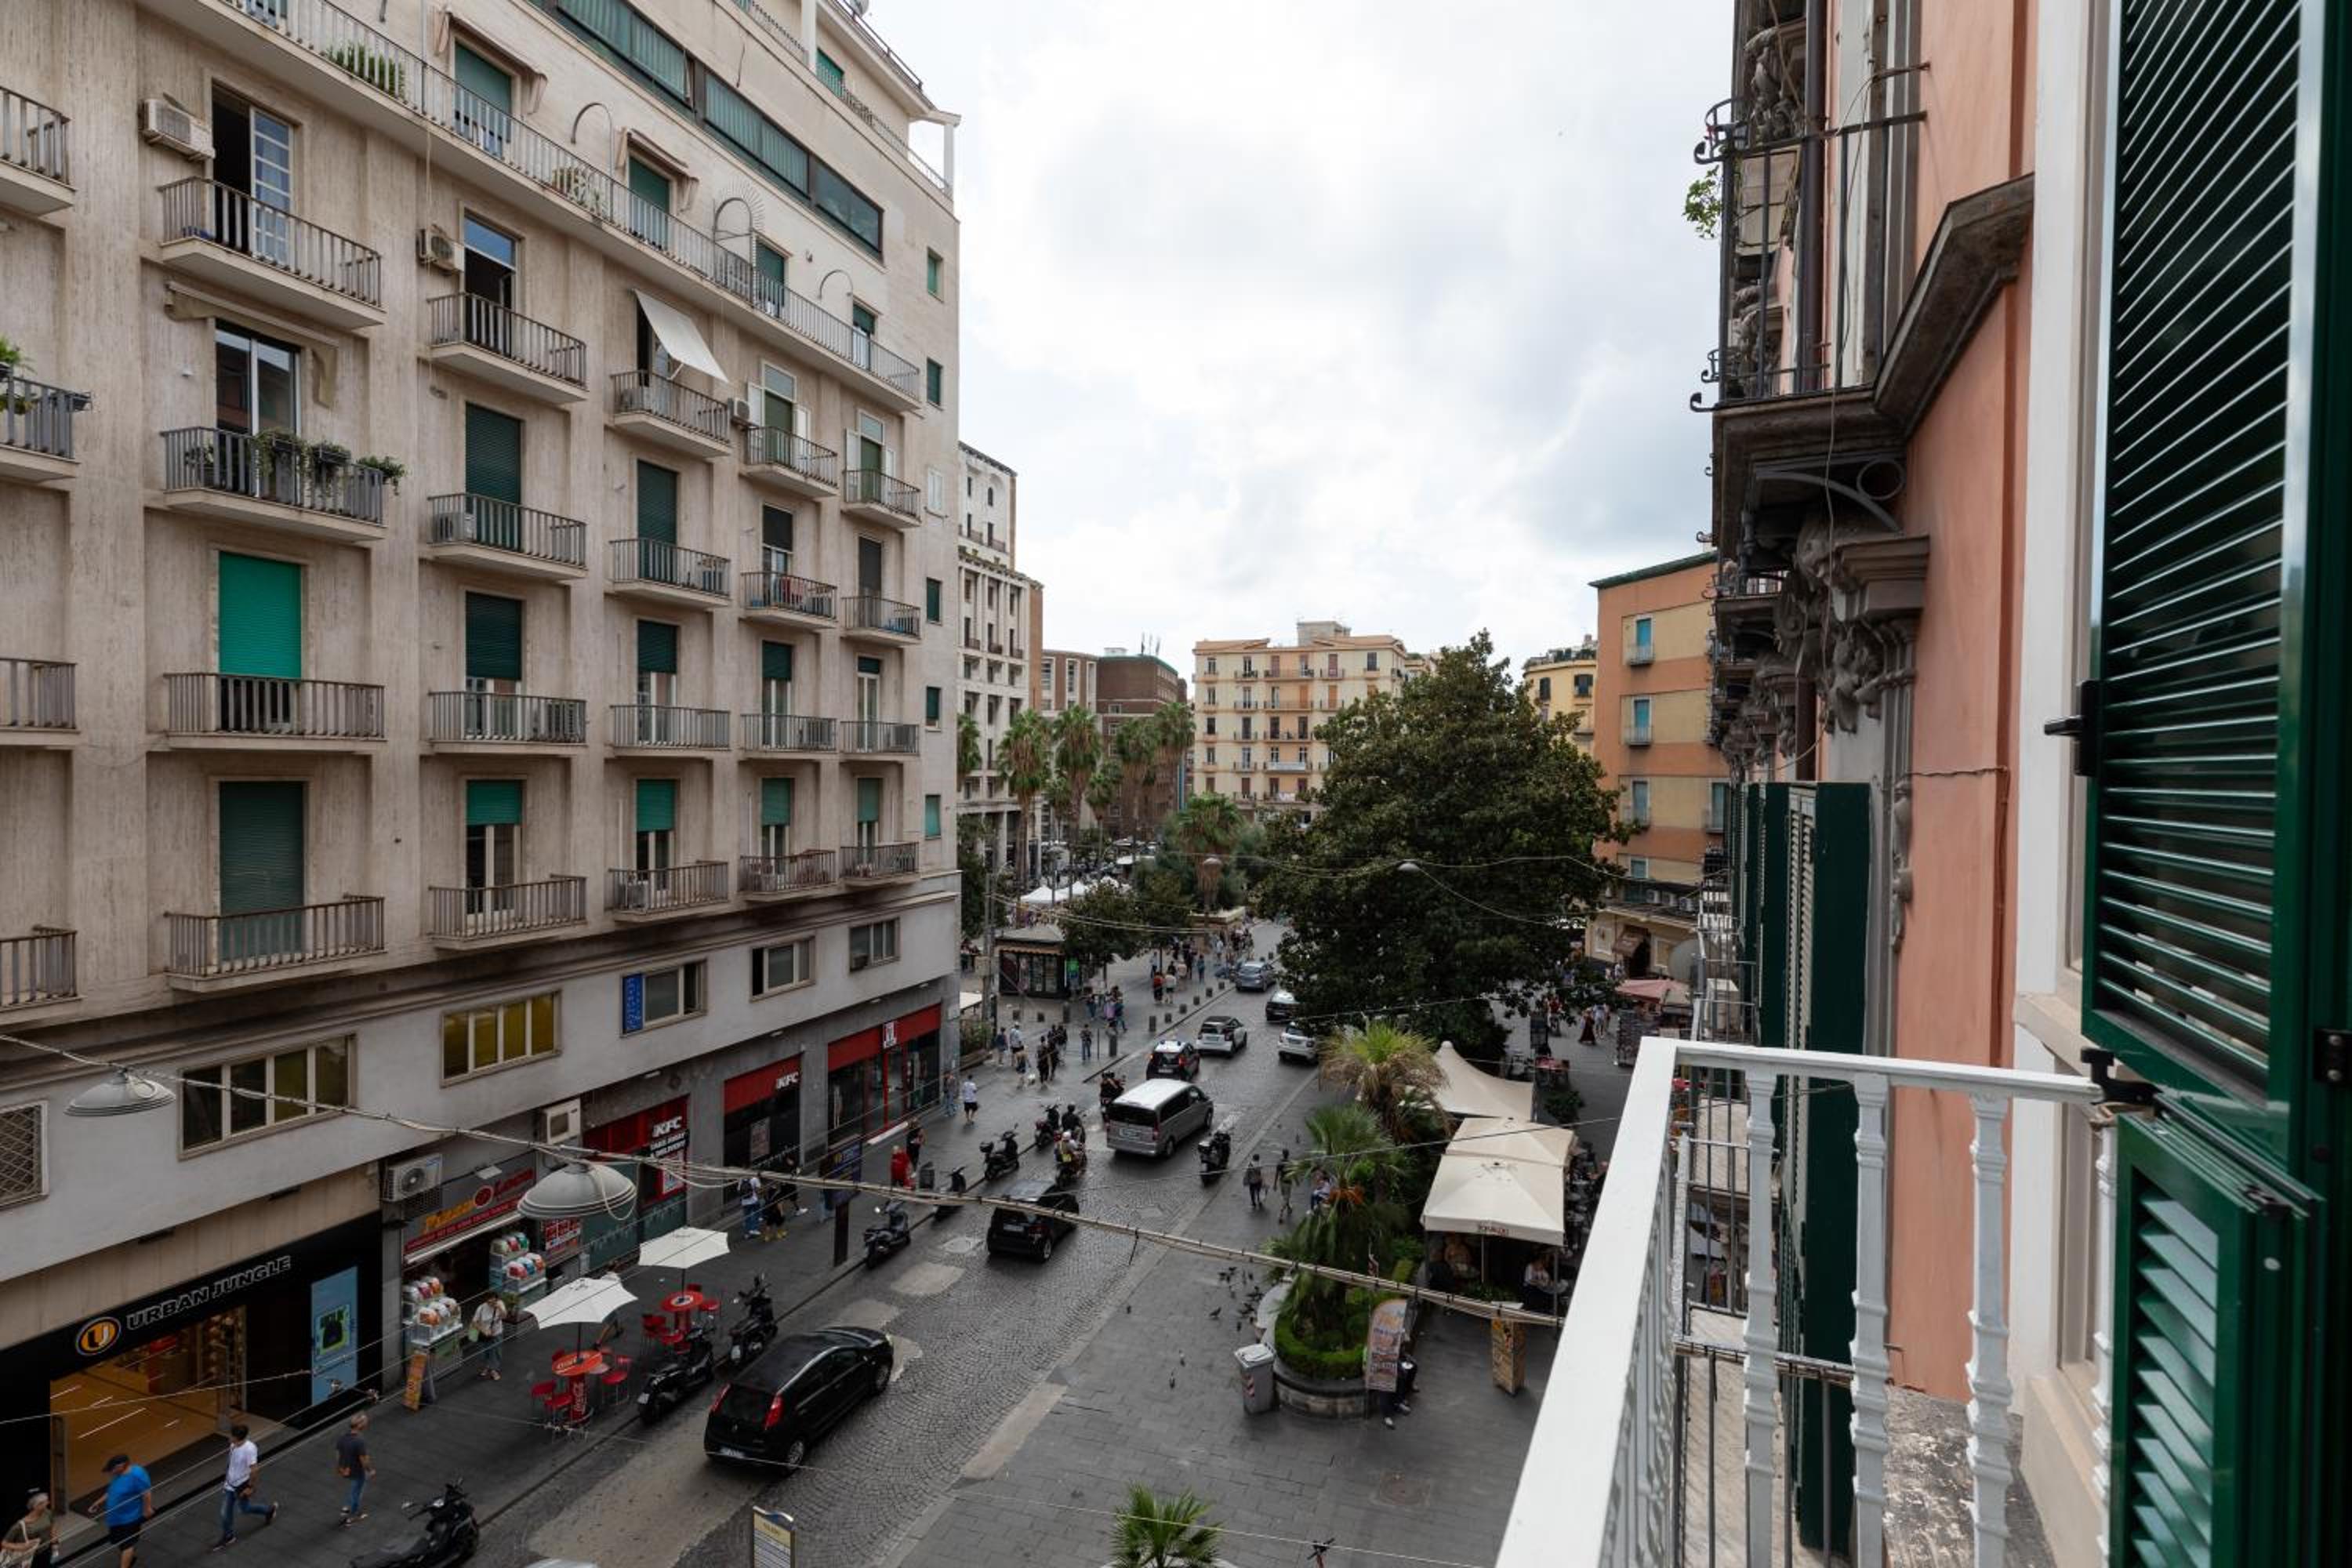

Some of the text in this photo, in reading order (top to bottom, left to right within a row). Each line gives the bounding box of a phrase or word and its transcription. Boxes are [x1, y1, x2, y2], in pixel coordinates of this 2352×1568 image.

[775, 1070, 799, 1089] KFC
[652, 1116, 683, 1138] KFC
[126, 1255, 291, 1330] URBAN JUNGLE
[87, 1325, 109, 1348] U
